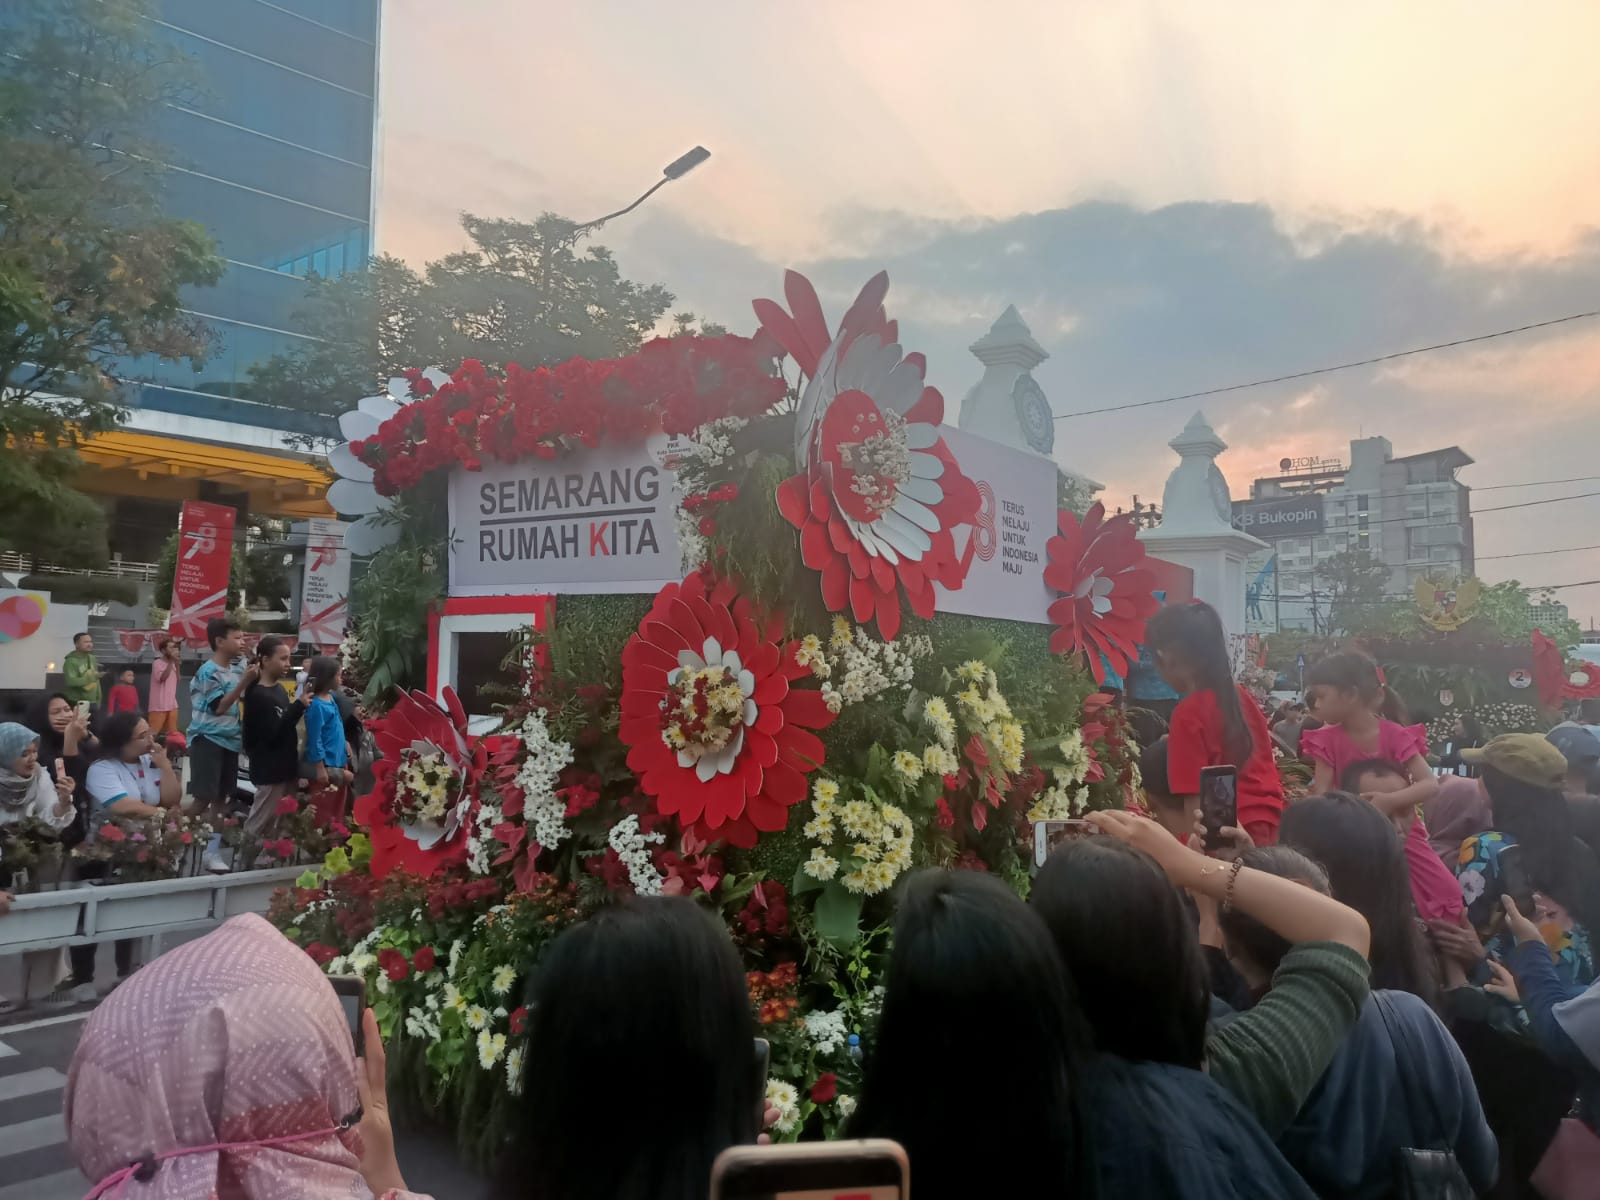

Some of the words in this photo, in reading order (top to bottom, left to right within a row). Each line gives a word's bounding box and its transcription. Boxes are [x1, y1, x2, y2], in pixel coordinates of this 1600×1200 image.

[1292, 456, 1319, 468] HOM
[479, 465, 659, 515] SEMARANG
[1002, 500, 1025, 516] TERUS
[1002, 516, 1030, 532] MELAJU
[1232, 513, 1254, 526] KB
[1259, 508, 1318, 525] Bukopin
[183, 521, 217, 560] 78
[479, 524, 579, 562] RUMAH
[589, 518, 659, 556] KITA
[1002, 531, 1026, 546] UNTUK
[1002, 546, 1039, 563] INDONESIA
[1002, 561, 1023, 575] MAJU
[1515, 671, 1524, 681] 2
